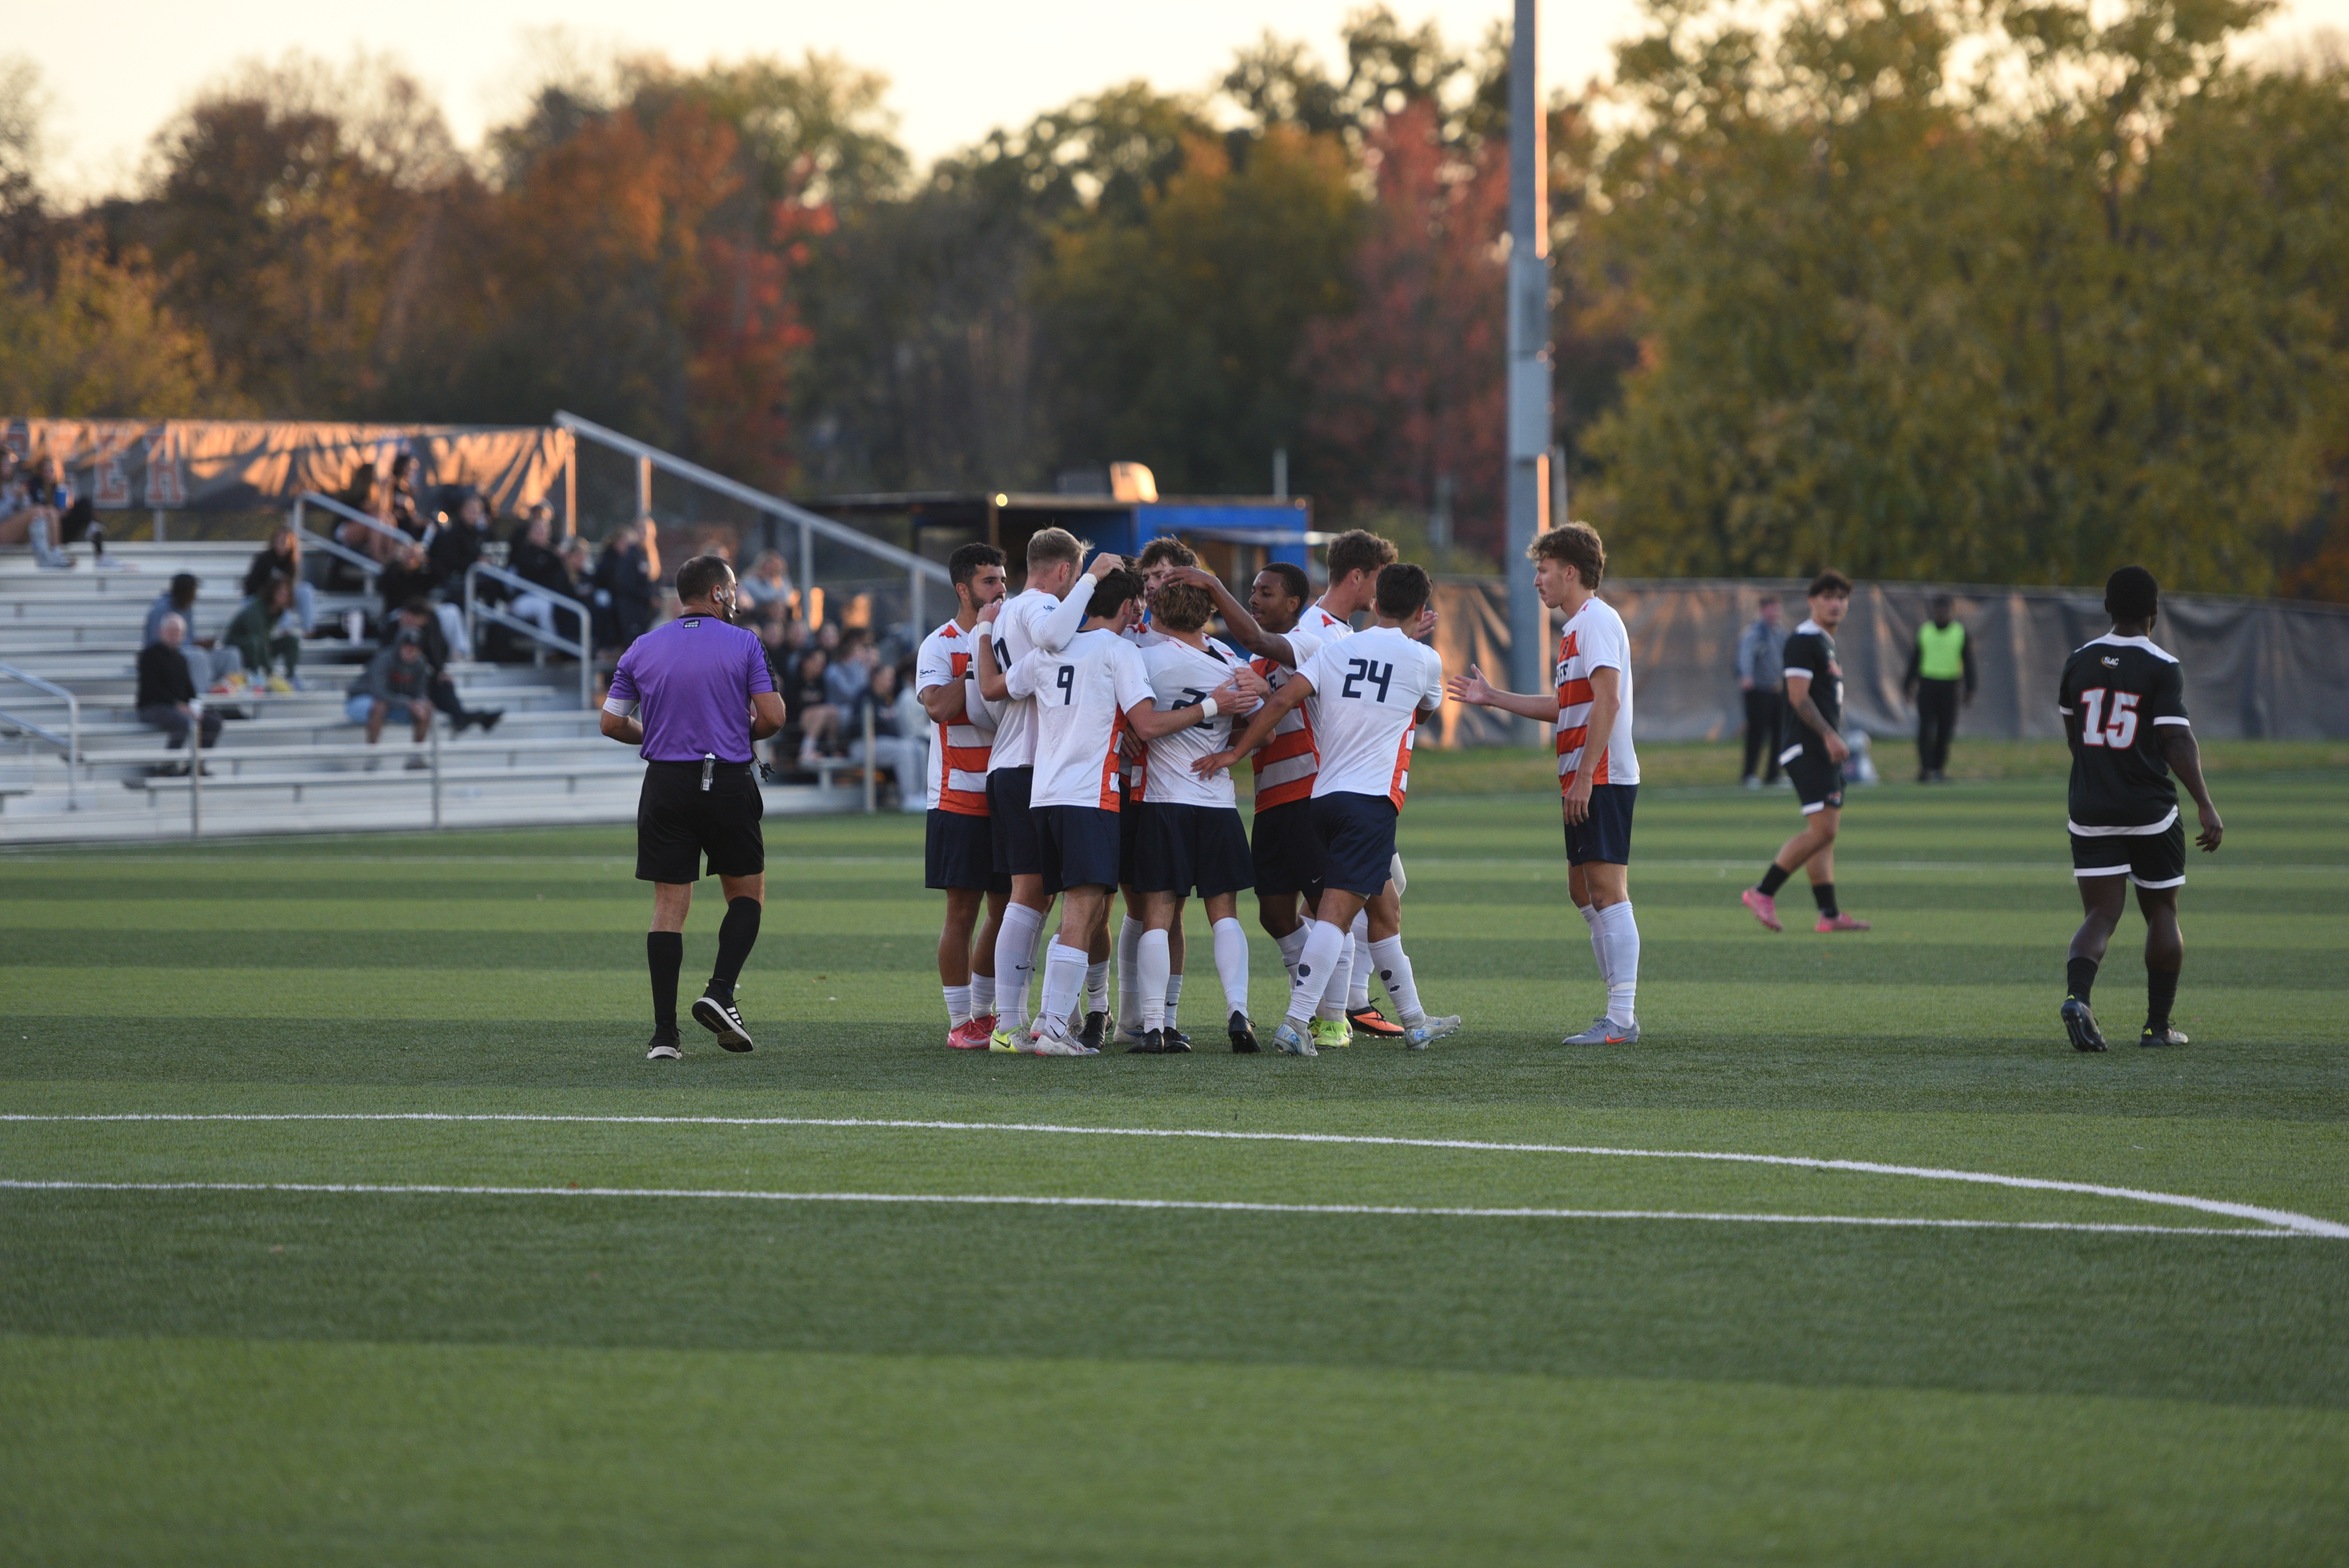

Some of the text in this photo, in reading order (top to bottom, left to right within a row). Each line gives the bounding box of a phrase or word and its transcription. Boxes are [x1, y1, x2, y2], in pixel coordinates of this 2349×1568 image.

[1056, 664, 1075, 705] 9
[1341, 658, 1393, 703] 24
[2080, 686, 2142, 750] 15
